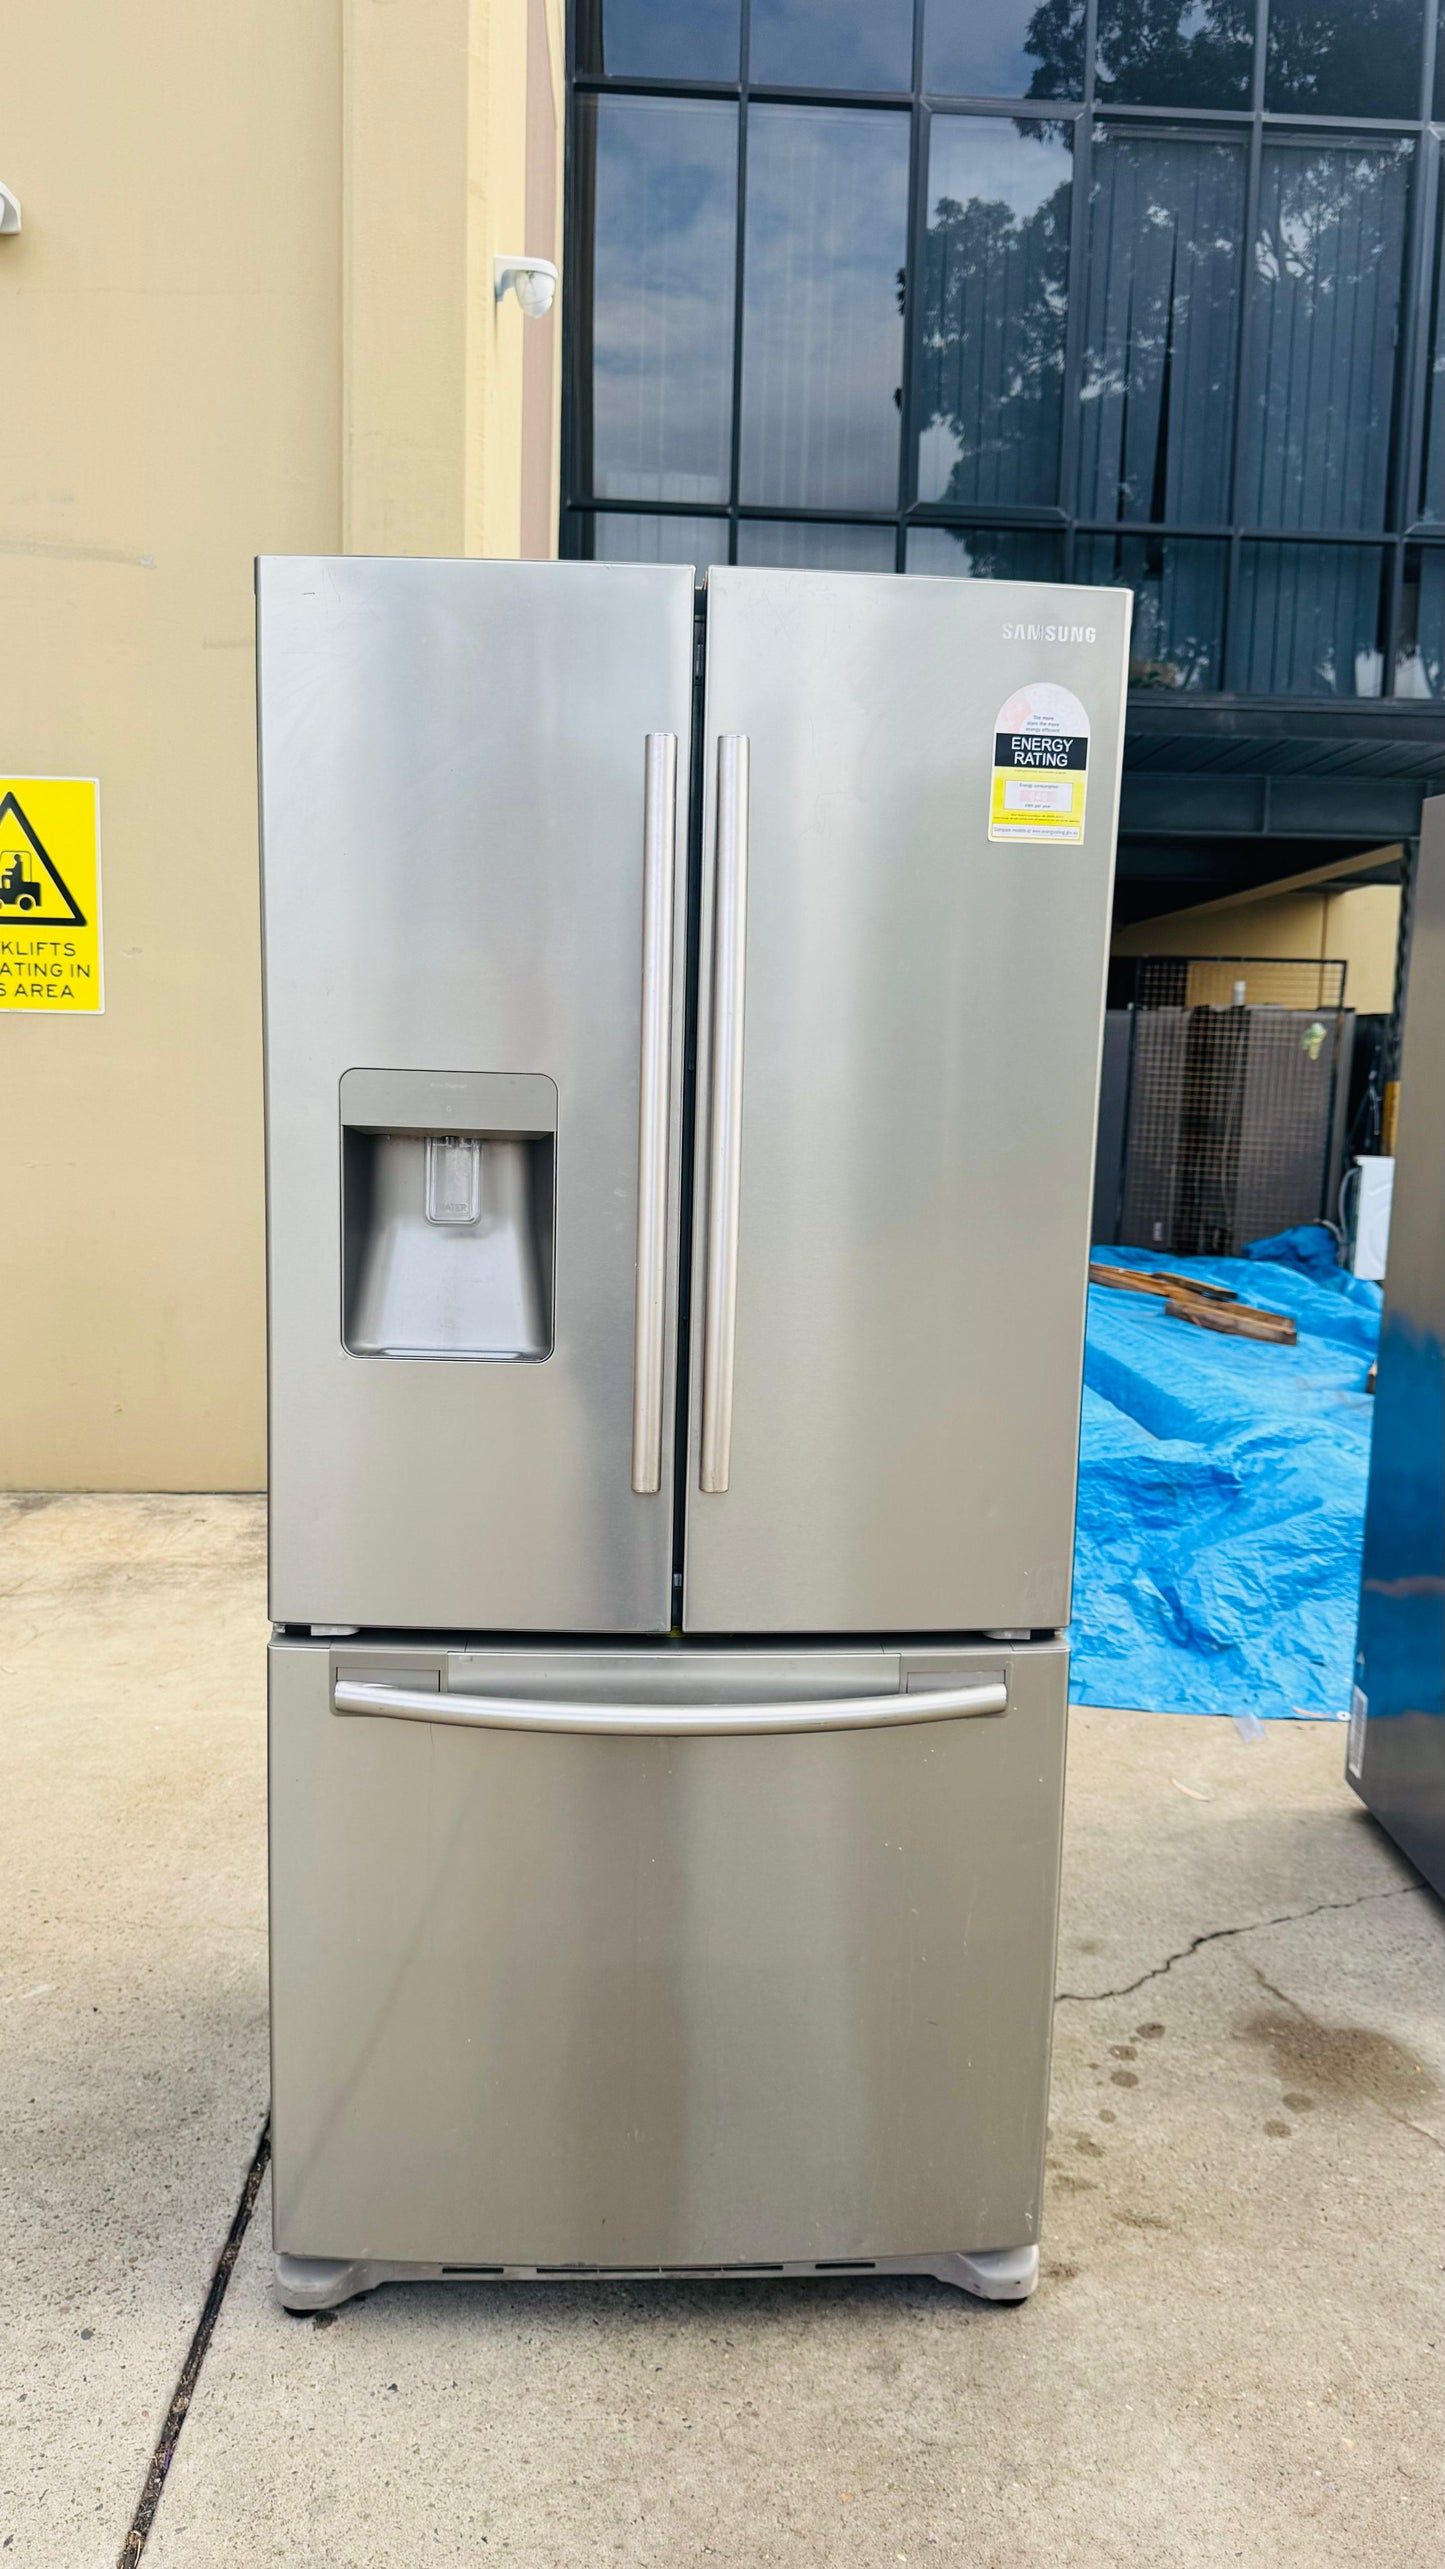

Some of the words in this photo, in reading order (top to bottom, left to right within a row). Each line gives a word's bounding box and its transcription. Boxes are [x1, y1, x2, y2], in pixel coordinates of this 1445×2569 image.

[1001, 623, 1096, 643] SAMSUNG
[1011, 736, 1073, 753] ENERGY
[1014, 751, 1068, 767] RATING
[1, 941, 76, 957] KLIFTS
[0, 962, 63, 977] ATING
[70, 963, 90, 978] IN
[14, 983, 75, 999] AREA
